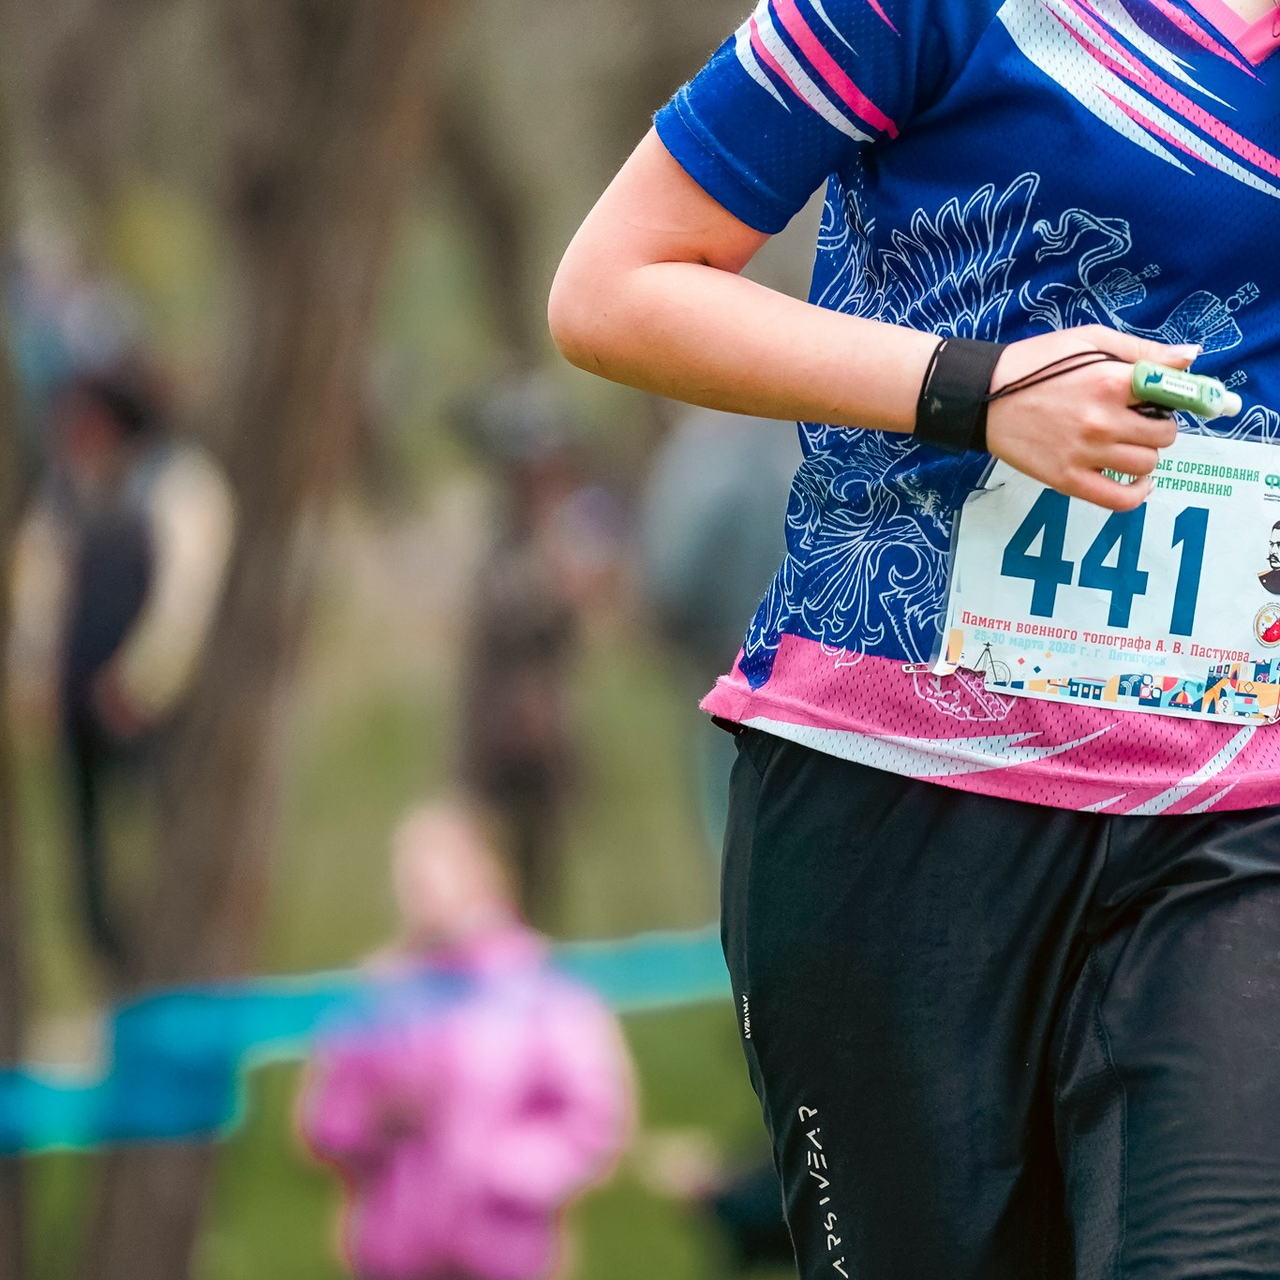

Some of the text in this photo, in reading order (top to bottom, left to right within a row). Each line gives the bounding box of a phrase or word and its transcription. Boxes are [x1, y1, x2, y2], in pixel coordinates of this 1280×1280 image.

[1176, 461, 1260, 483] СОРЕВНОВАНИЯ
[1001, 488, 1210, 637] 441
[961, 611, 1250, 663] Памяти военного топографа А. В. Пастухова
[973, 629, 1006, 645] 25-30
[1009, 636, 1044, 651] марта
[1109, 649, 1167, 667] Пятигорск
